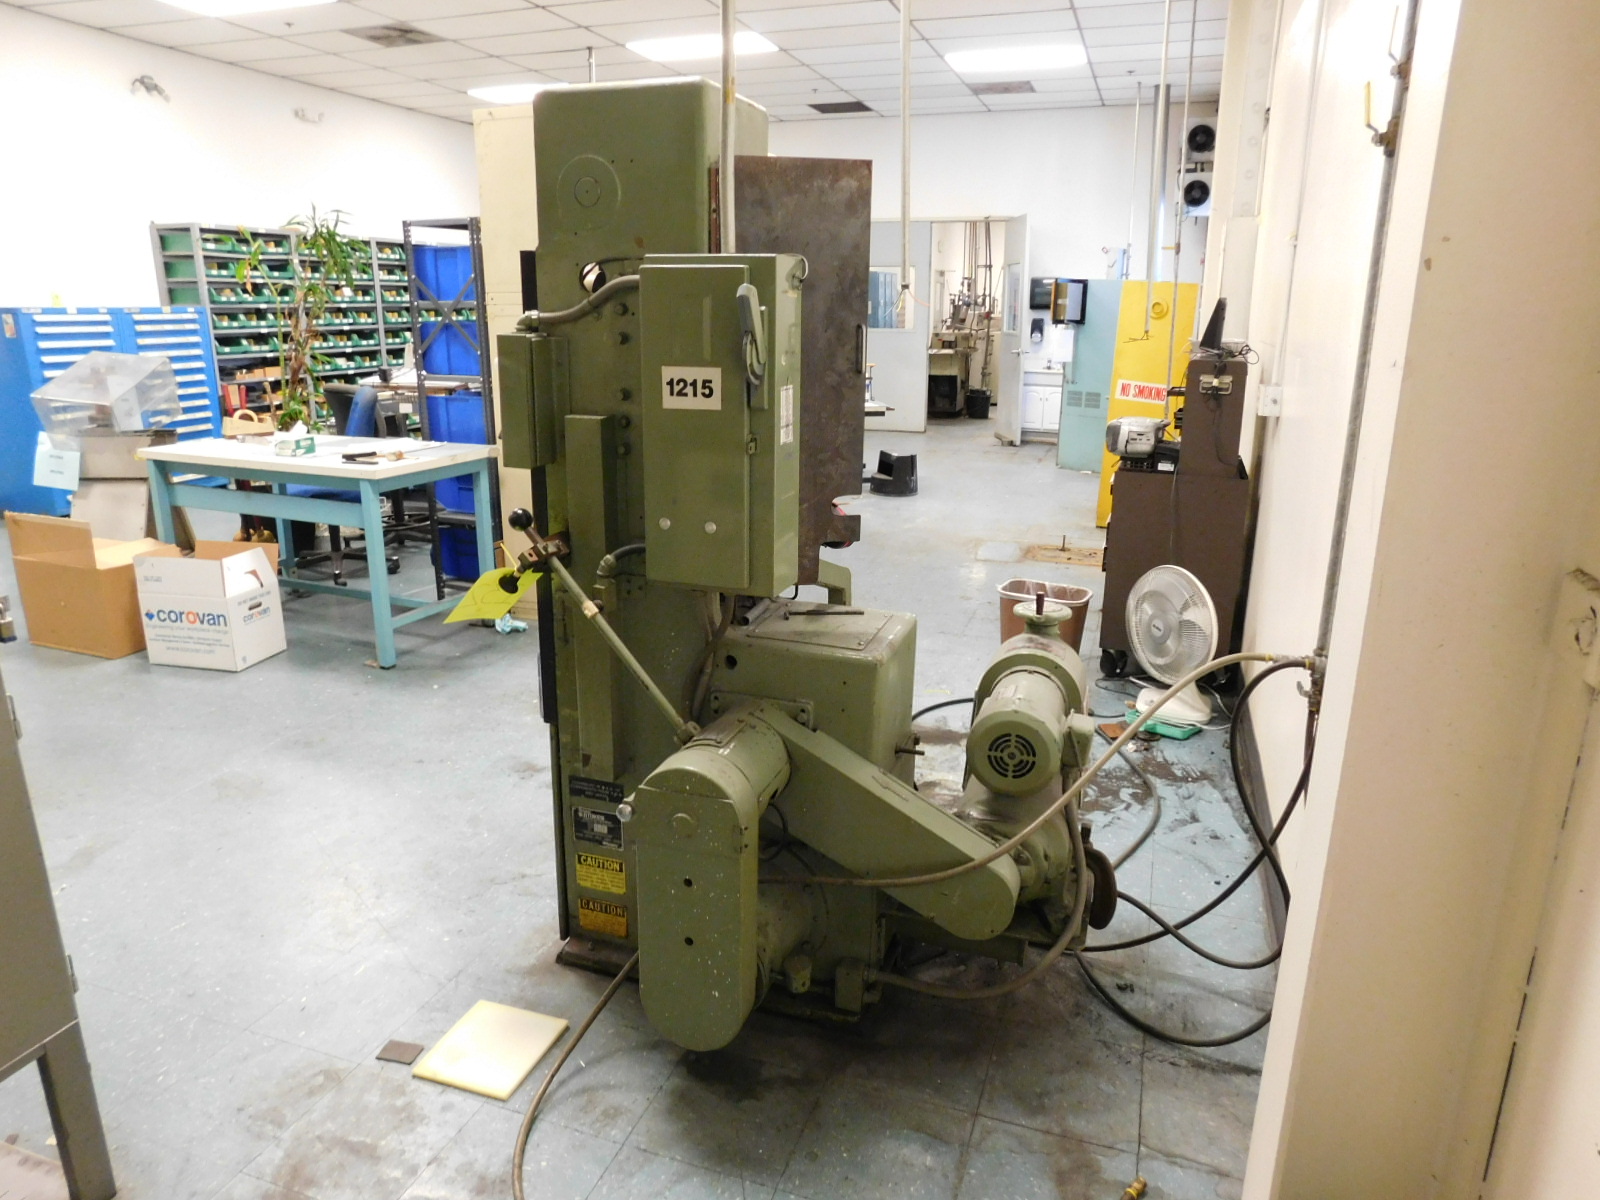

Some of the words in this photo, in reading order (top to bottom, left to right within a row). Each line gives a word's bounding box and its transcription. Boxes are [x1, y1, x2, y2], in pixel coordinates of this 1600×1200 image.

[666, 377, 714, 398] 1215
[1120, 382, 1131, 397] NO
[1132, 384, 1167, 402] SMOKING
[156, 609, 228, 627] corovan
[580, 855, 620, 871] CAUTION
[582, 898, 624, 916] CAUTION
